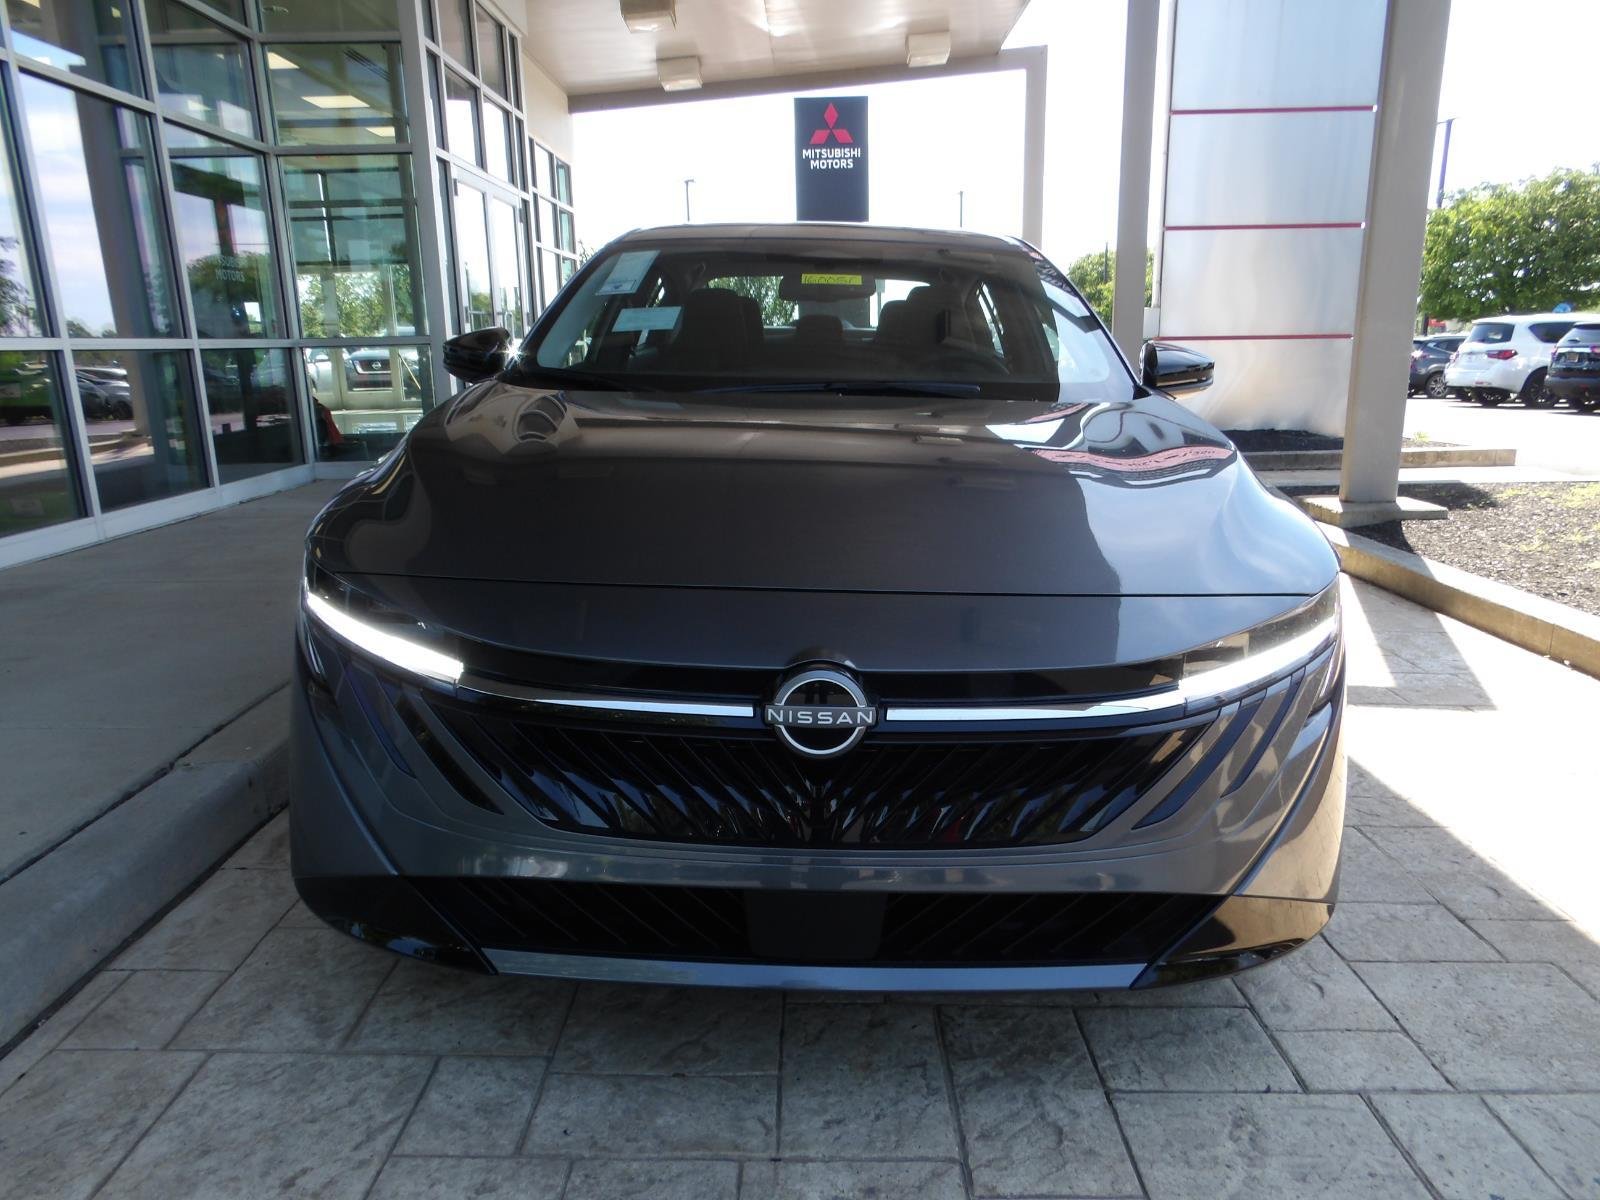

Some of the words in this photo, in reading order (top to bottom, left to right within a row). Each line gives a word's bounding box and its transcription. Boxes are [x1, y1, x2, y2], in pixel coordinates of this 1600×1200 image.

[802, 148, 861, 159] MITSUBISHI
[810, 159, 854, 170] MOTORS
[767, 708, 873, 725] NISSAN
